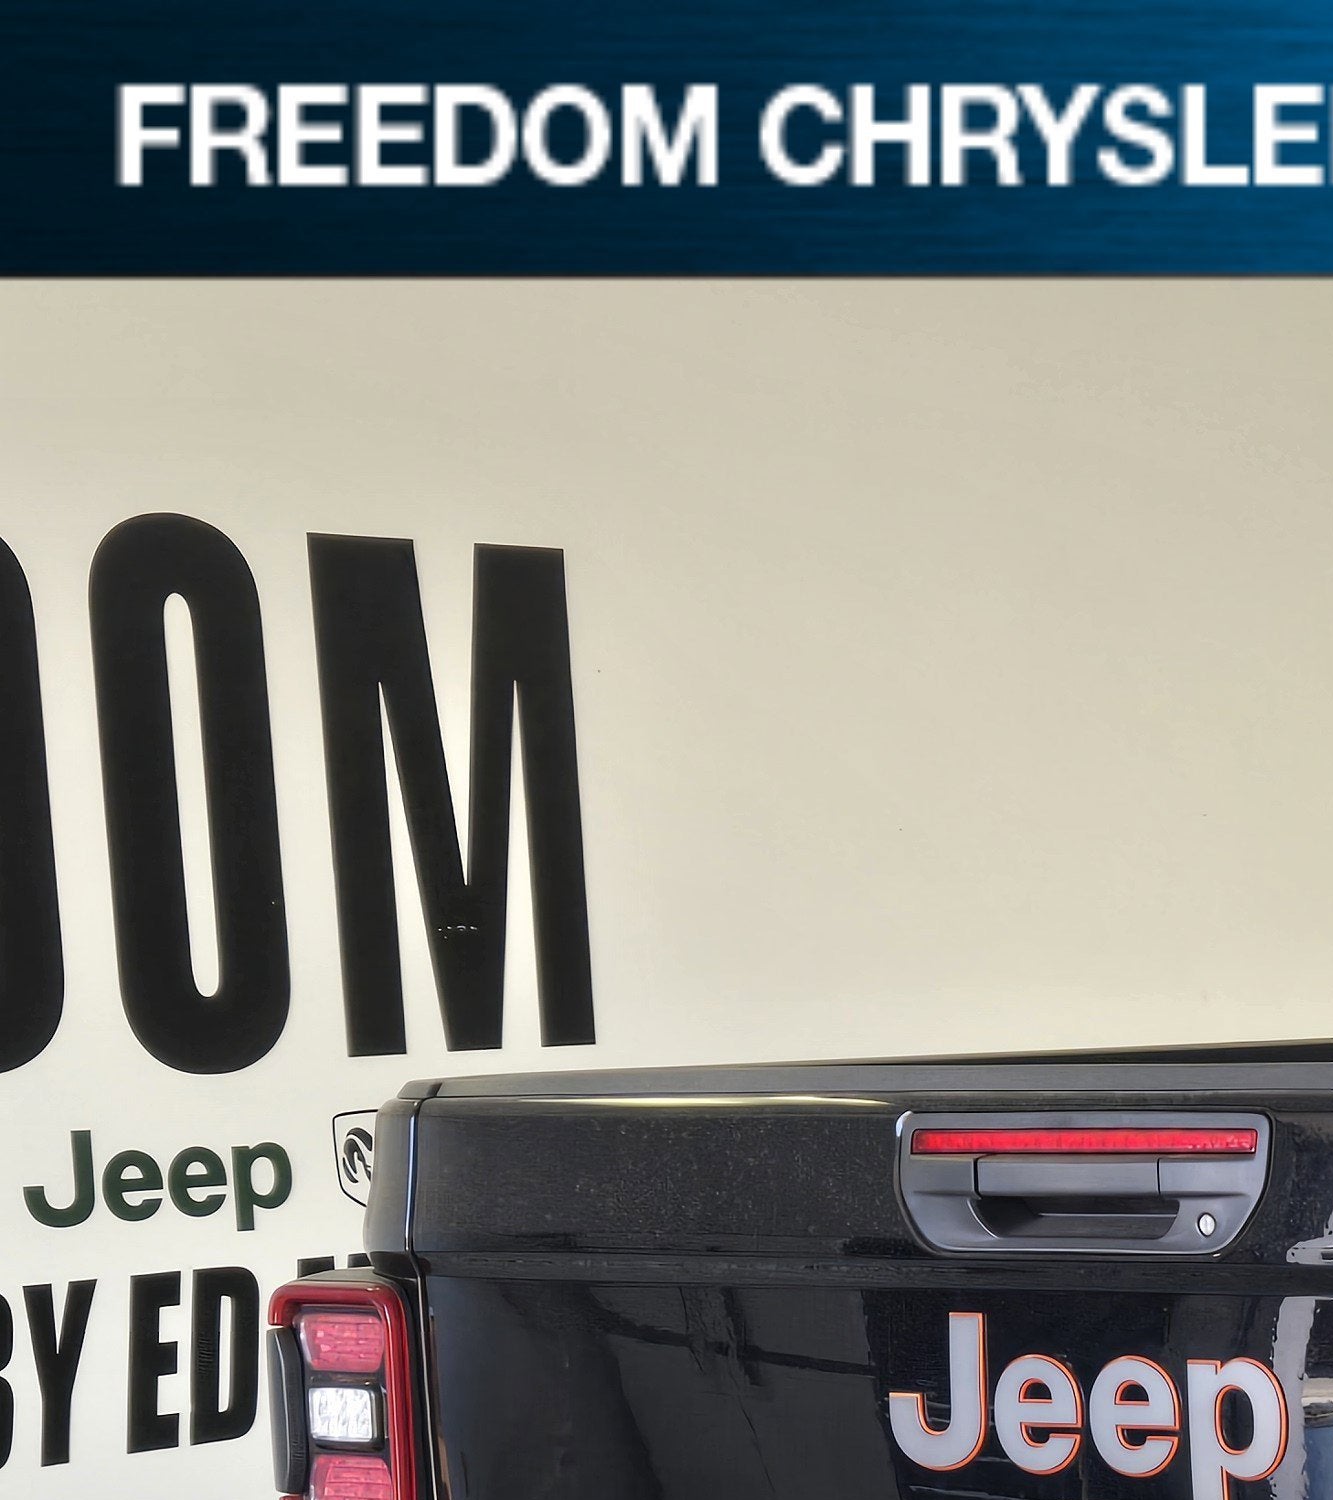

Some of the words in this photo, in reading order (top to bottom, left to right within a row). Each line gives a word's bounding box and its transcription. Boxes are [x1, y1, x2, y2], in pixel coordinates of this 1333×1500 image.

[23, 1129, 292, 1231] Jeep
[0, 1278, 97, 1470] Y
[127, 1266, 260, 1454] ED
